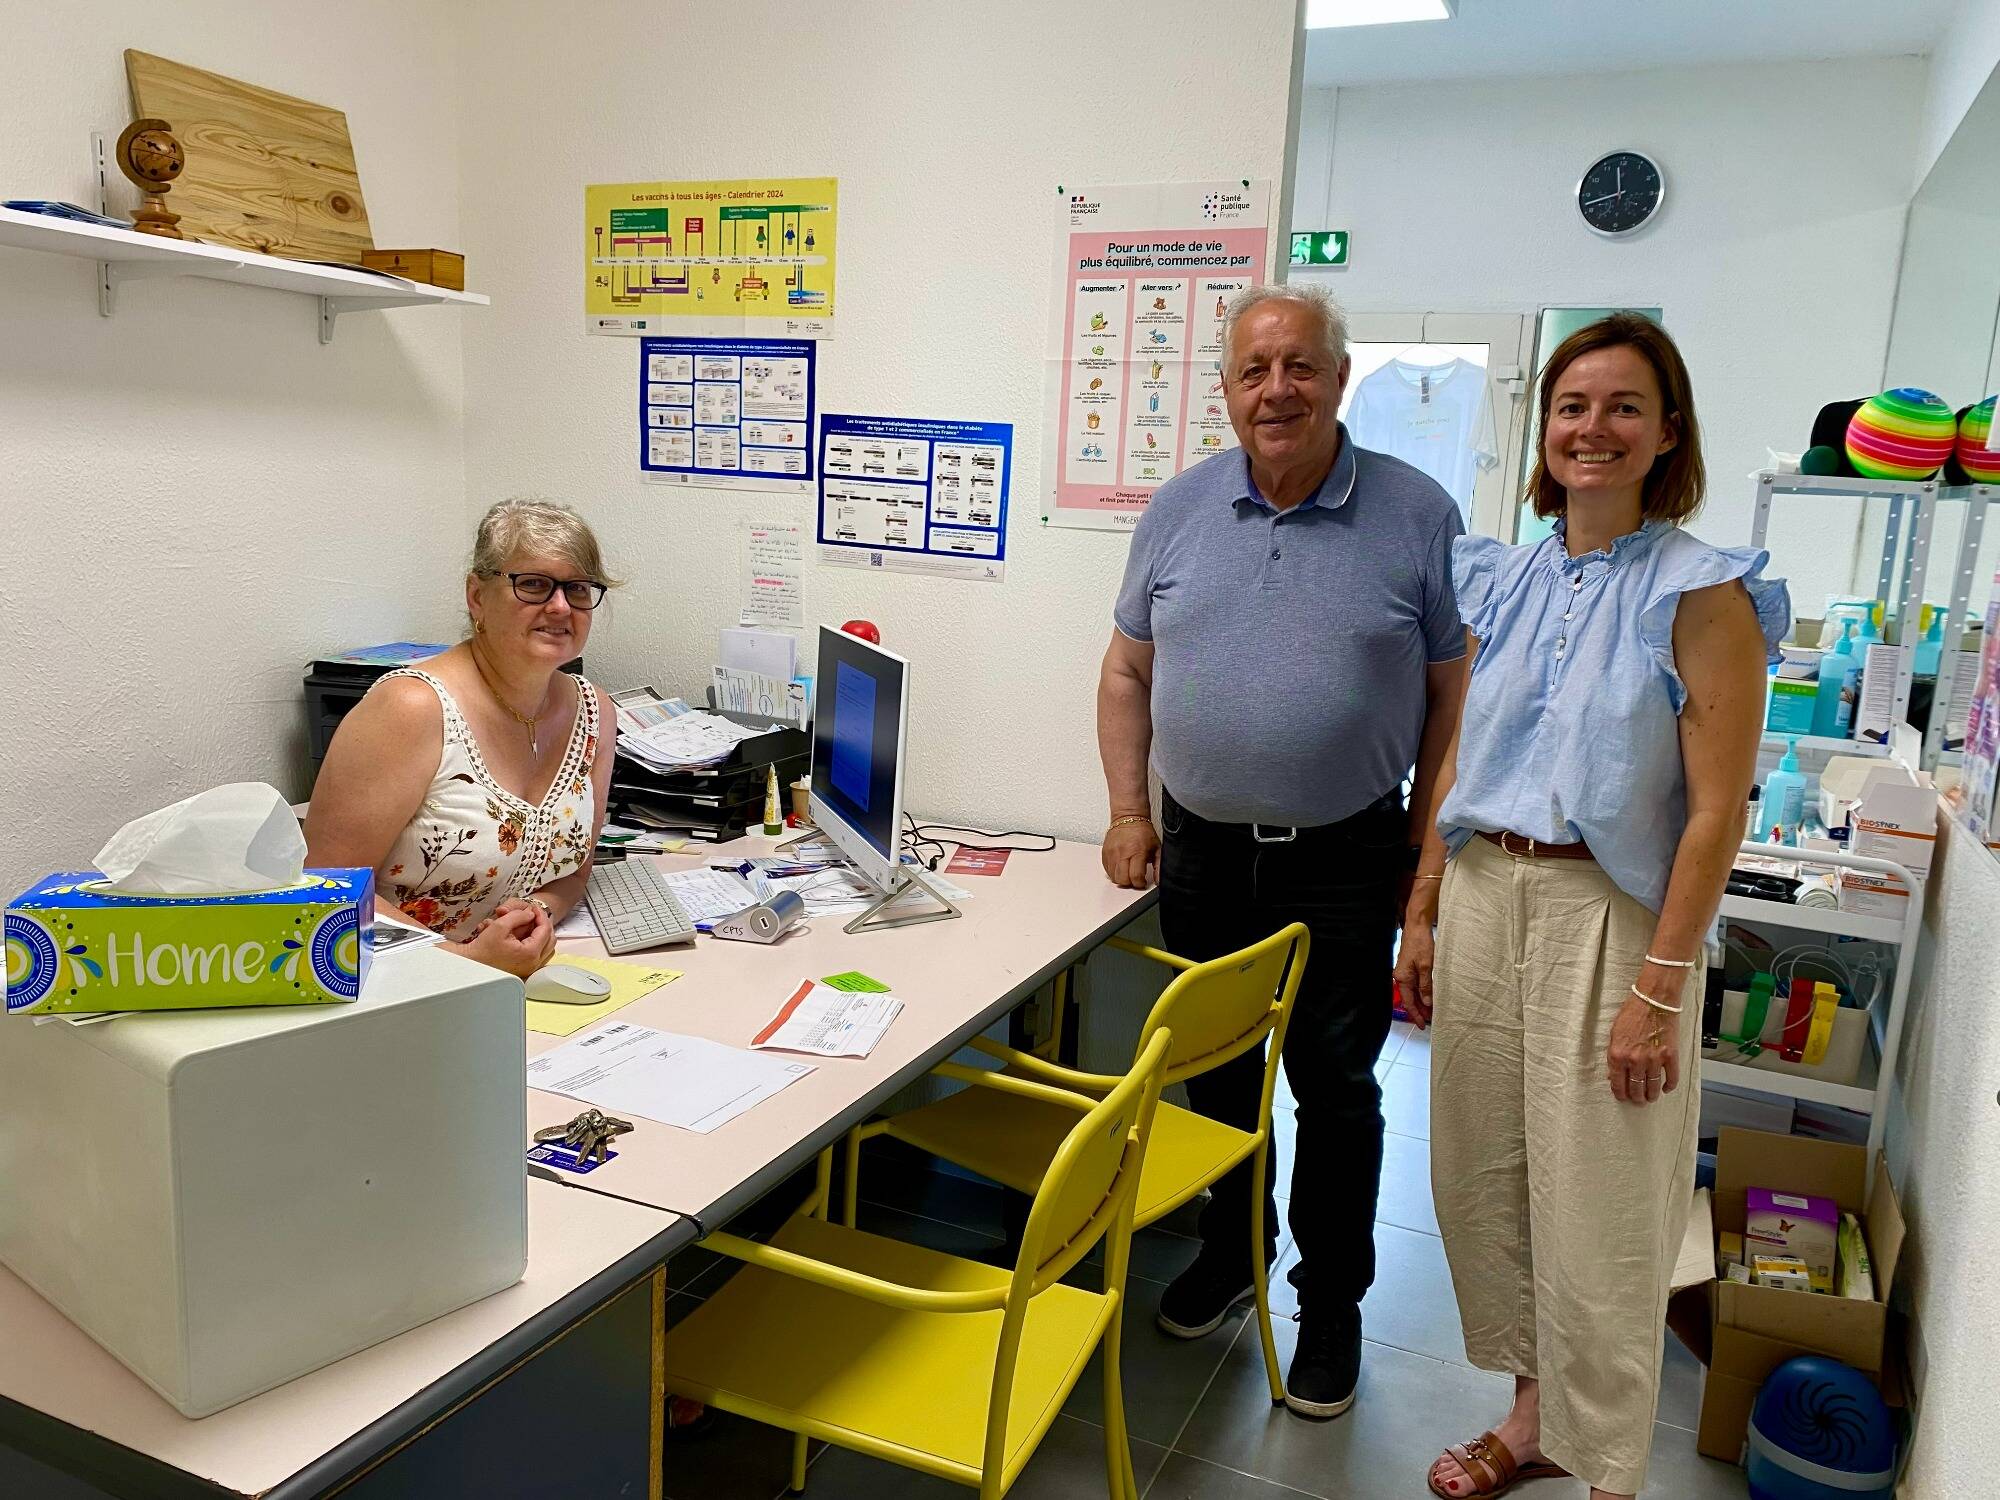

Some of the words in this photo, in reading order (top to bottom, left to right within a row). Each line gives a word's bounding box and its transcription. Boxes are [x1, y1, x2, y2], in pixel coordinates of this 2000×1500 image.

[645, 192, 669, 201] vaccins
[671, 192, 675, 200] à
[676, 192, 691, 200] tous
[693, 192, 704, 200] les
[705, 191, 722, 201] âges
[728, 190, 765, 199] Calendrier
[767, 190, 784, 198] 2024
[1221, 194, 1241, 202] Santé
[1220, 202, 1250, 211] publique
[1108, 243, 1135, 254] Pour
[1136, 244, 1150, 253] un
[1152, 241, 1185, 252] mode
[1188, 241, 1203, 252] de
[1206, 240, 1222, 251] vie
[1080, 257, 1103, 270] plus
[1105, 255, 1154, 269] équilibré,
[1158, 256, 1228, 266] commencez
[1231, 256, 1251, 267] par
[1860, 819, 1901, 830] BIOSYNEX
[1845, 876, 1886, 887] BIOSYNEX
[723, 926, 744, 936] CPTS
[107, 931, 266, 987] Home
